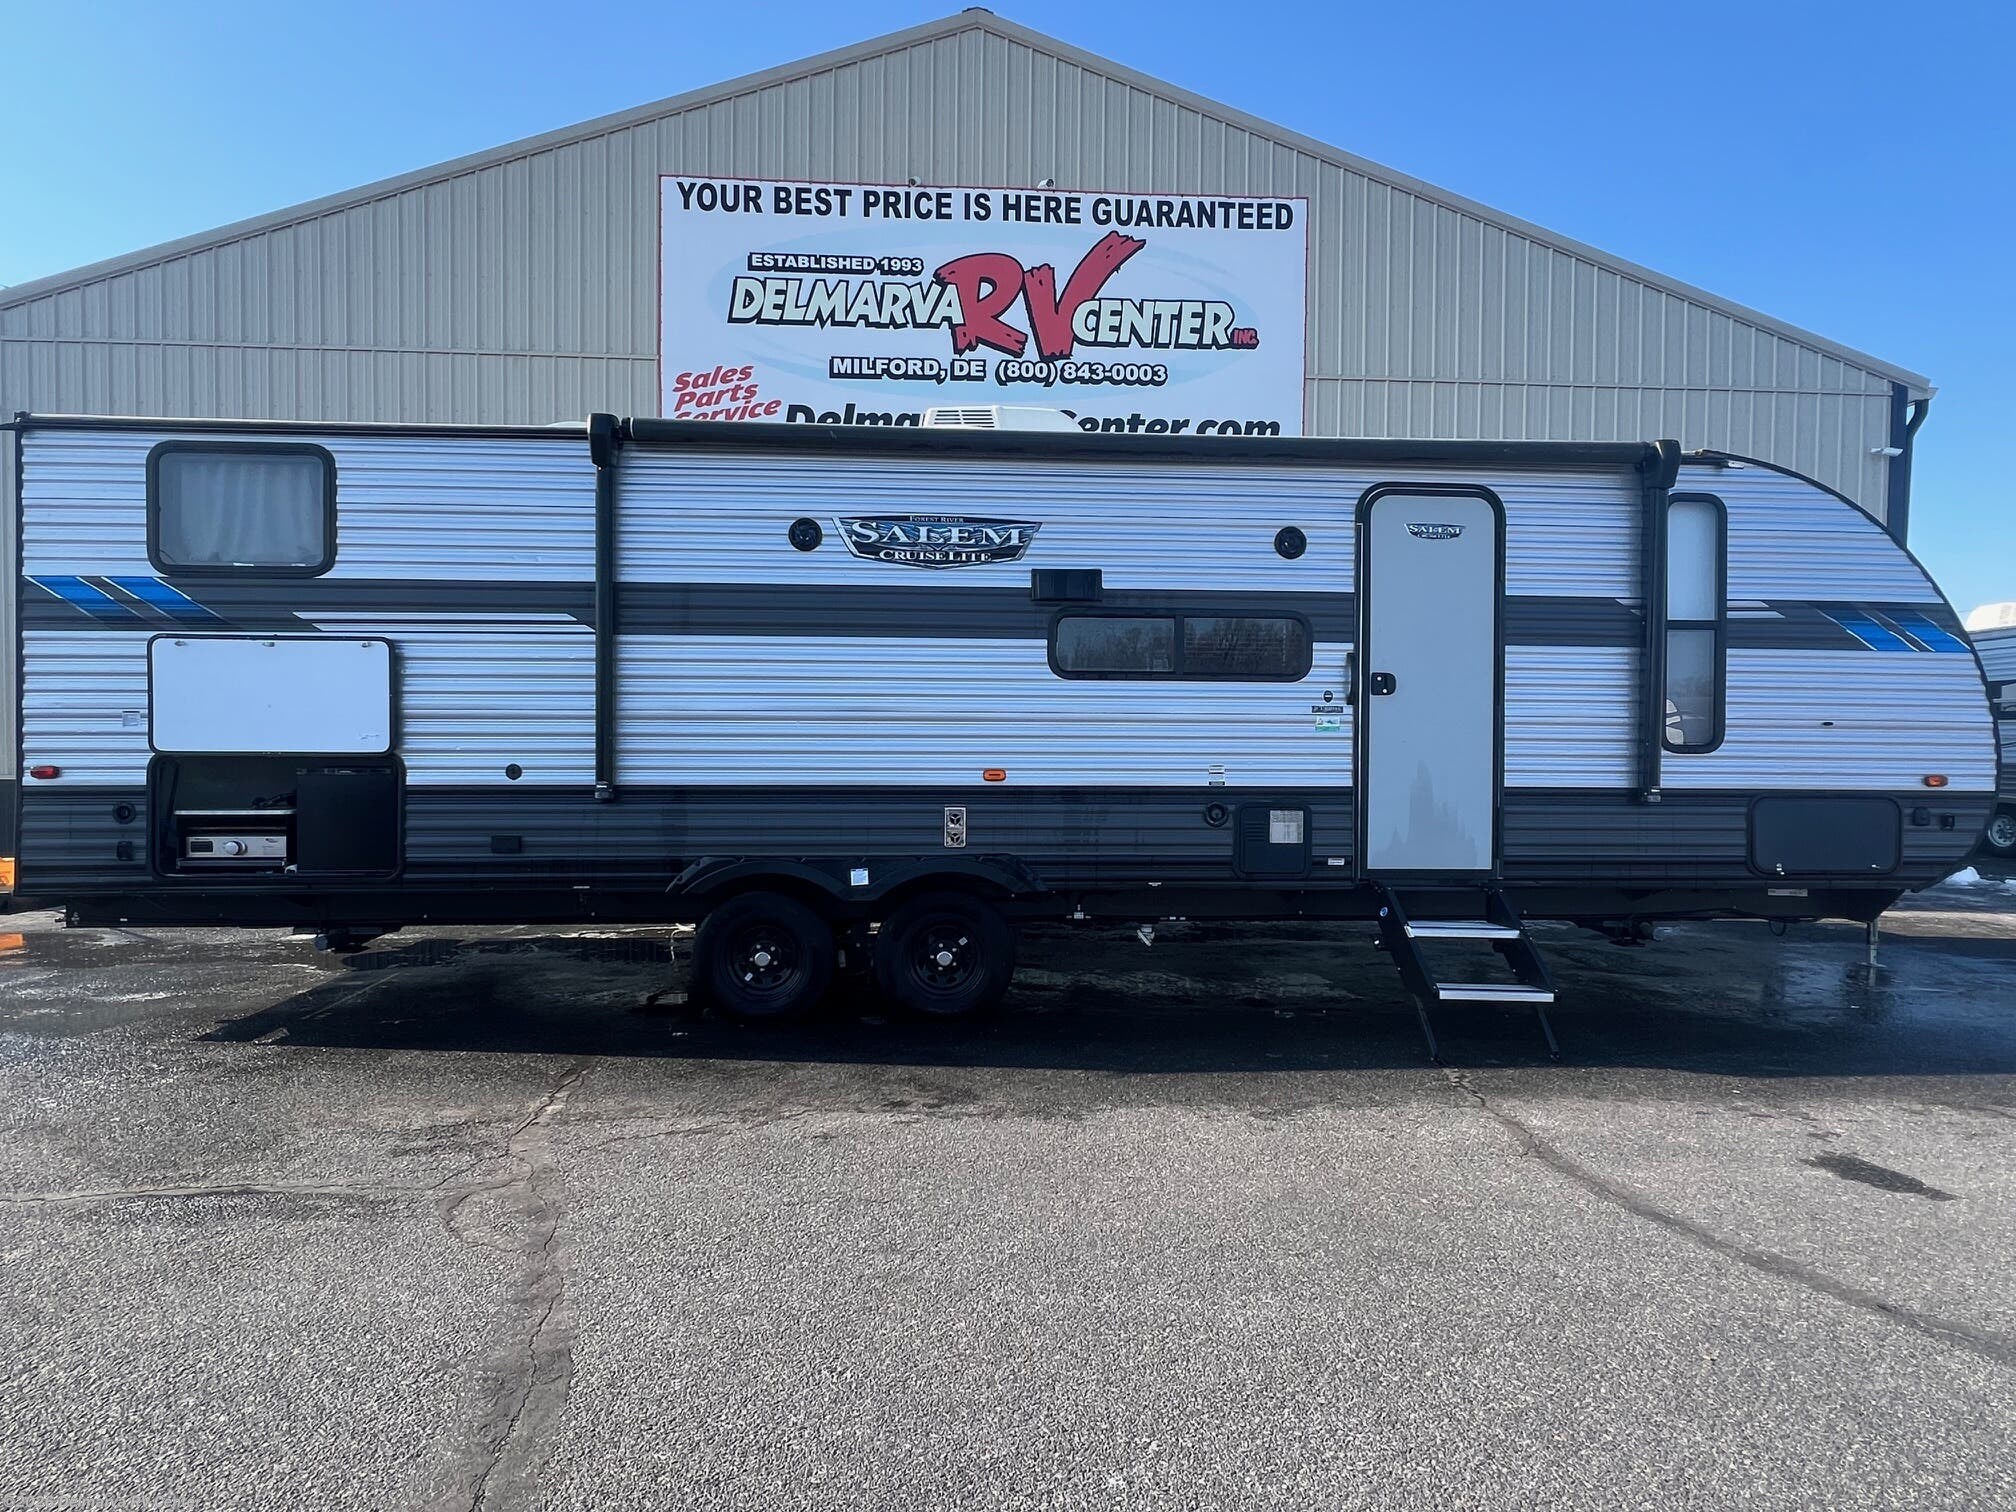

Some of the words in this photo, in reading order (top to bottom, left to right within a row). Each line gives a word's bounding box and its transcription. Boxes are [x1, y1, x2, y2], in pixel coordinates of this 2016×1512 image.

[677, 182, 763, 214] YOUR
[774, 187, 852, 216] BEST
[863, 190, 953, 219] PRICE
[964, 193, 992, 221] IS
[1002, 194, 1082, 224] HERE
[1092, 198, 1294, 230] GUARANTEED
[749, 253, 876, 273] ESTABLISHED
[878, 257, 924, 275] 1993
[728, 276, 966, 328] DELMARVA
[932, 231, 1147, 360] RV
[1072, 298, 1236, 349] CENTER
[672, 365, 754, 392] Sales
[947, 360, 986, 381] DE
[996, 361, 1058, 387] (800)
[1060, 362, 1168, 386] 843-0003
[674, 383, 759, 412] Parts
[851, 521, 1024, 546] SALEM
[1409, 524, 1461, 534] SALEM
